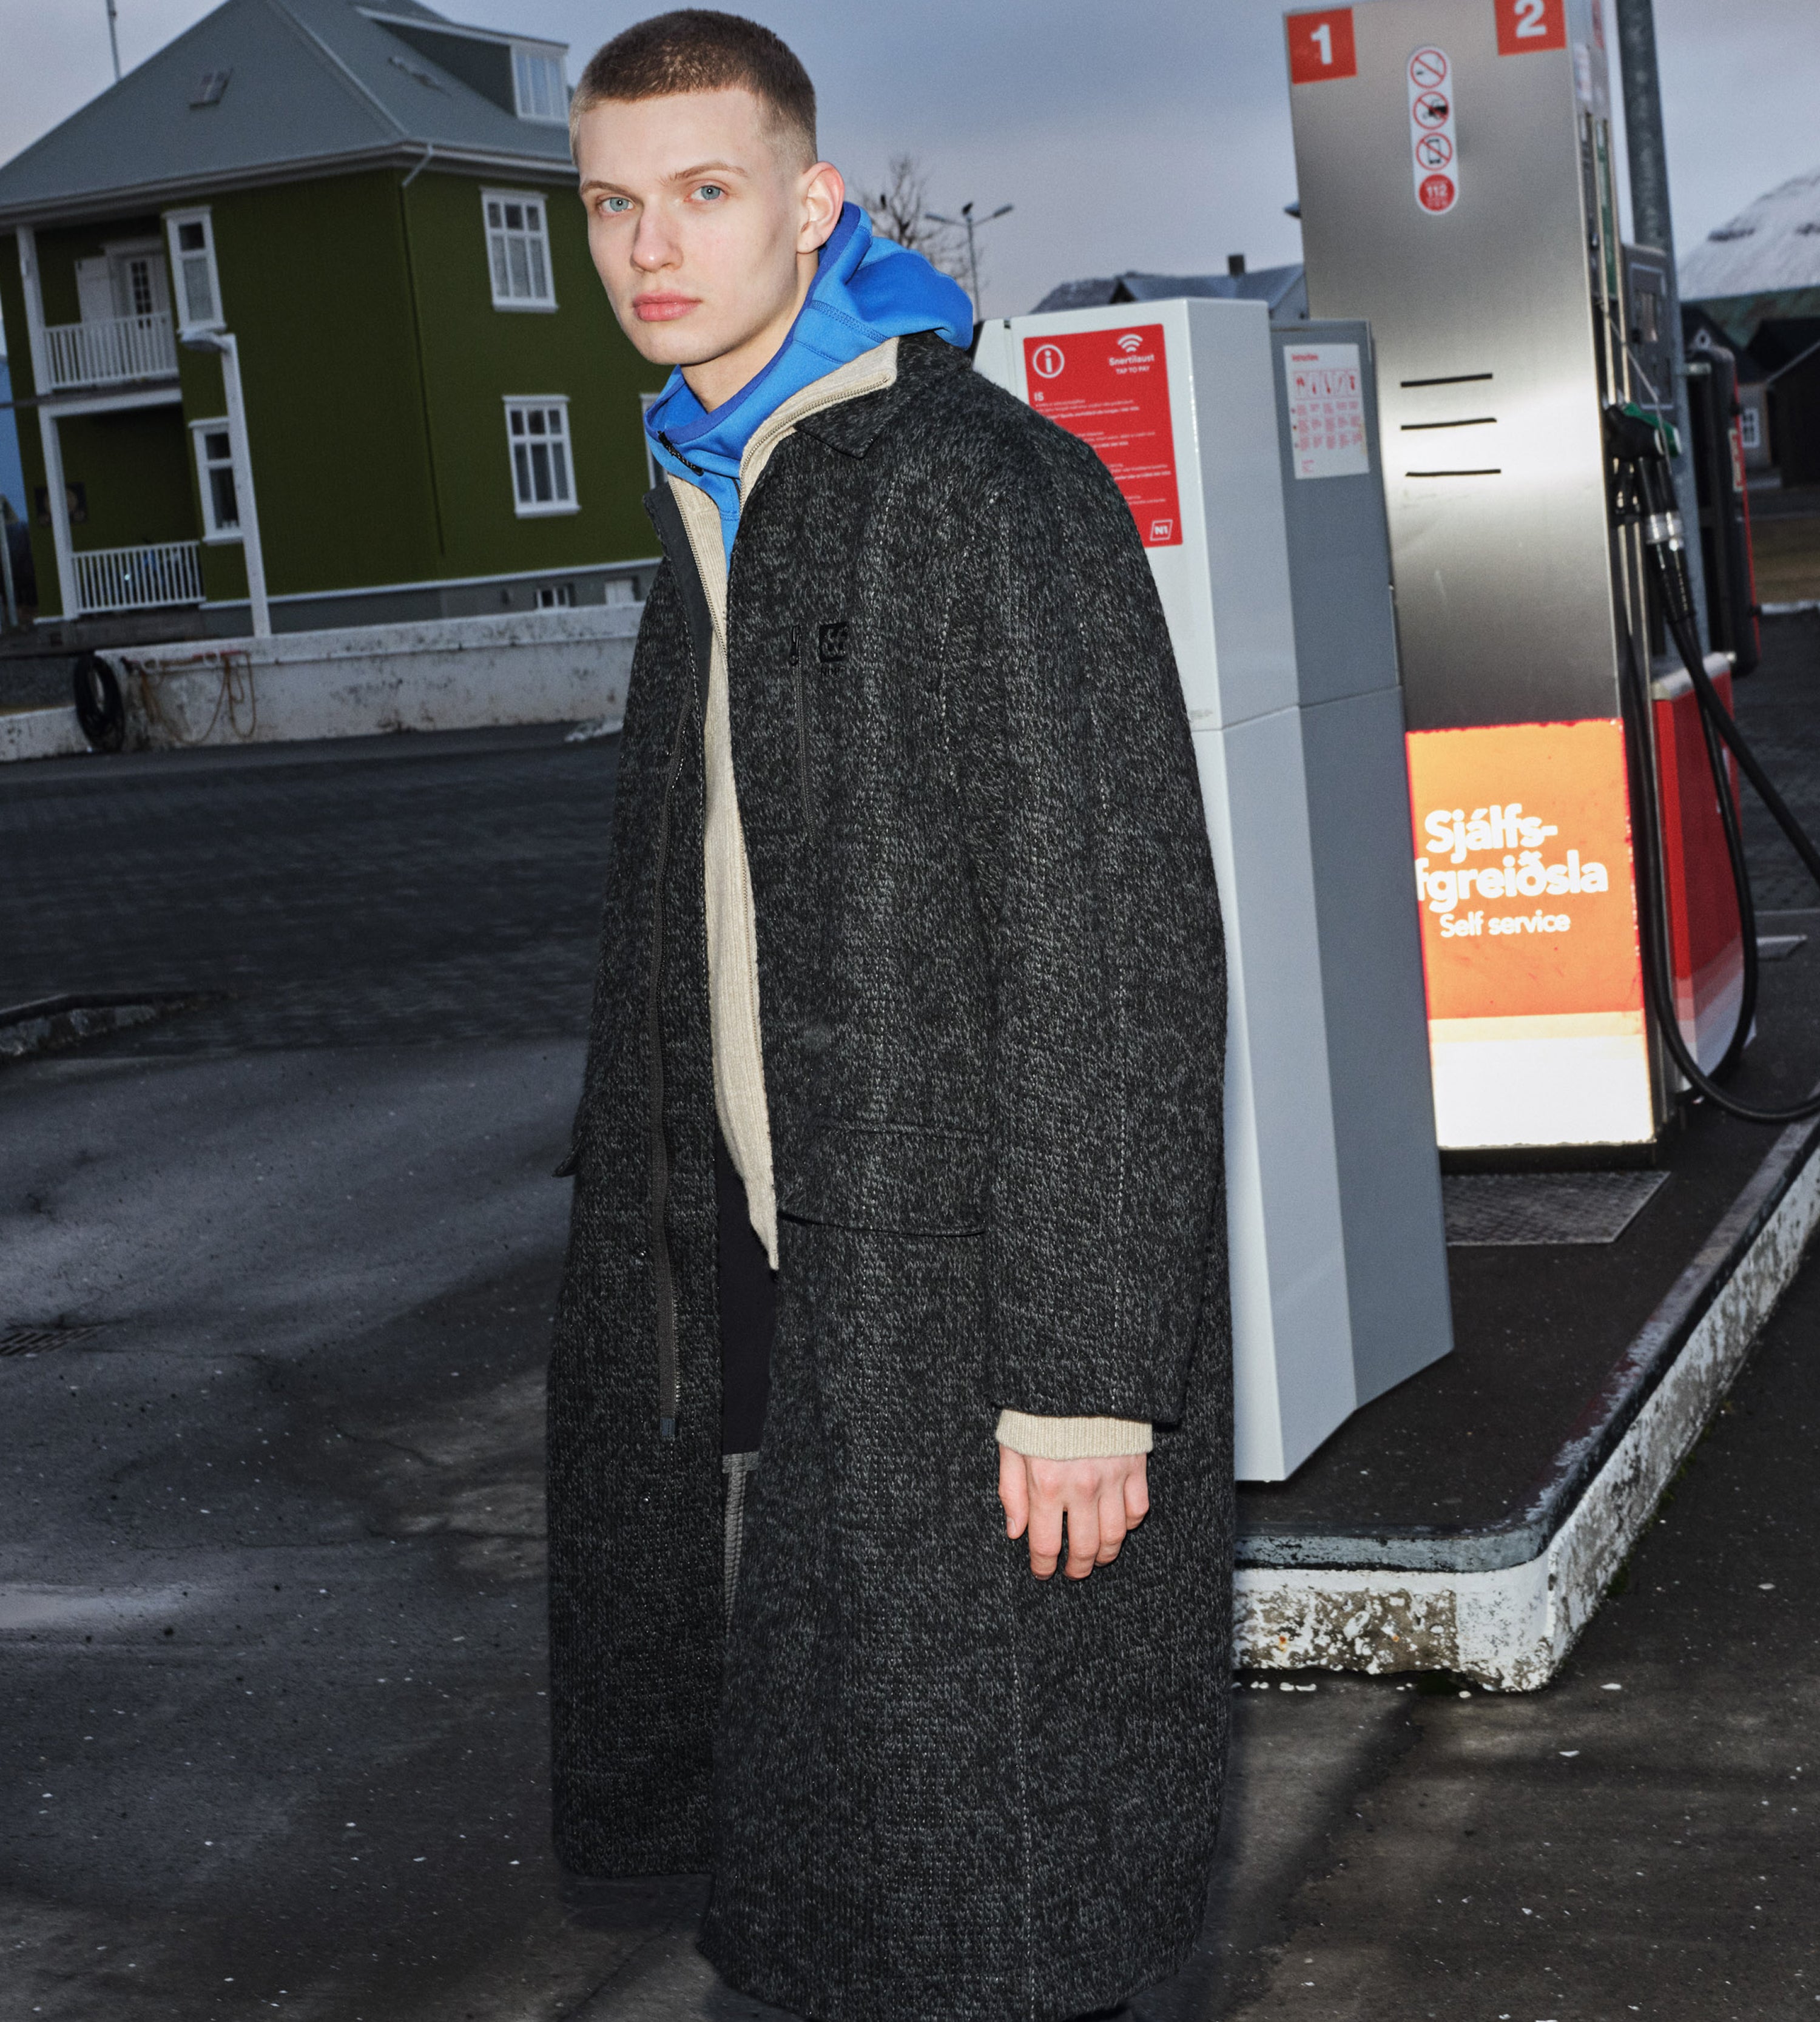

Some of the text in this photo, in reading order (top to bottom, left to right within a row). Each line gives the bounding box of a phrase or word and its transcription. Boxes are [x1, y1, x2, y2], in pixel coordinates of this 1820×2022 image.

[1514, 0, 1547, 38] 2
[1310, 24, 1333, 66] 1
[1426, 184, 1448, 197] 112
[1108, 354, 1154, 366] Snertilaust
[1154, 525, 1168, 535] N1
[1424, 803, 1558, 864] Sjálfs-
[1415, 849, 1608, 913] fgreiðsla
[1440, 909, 1571, 938] Self service
